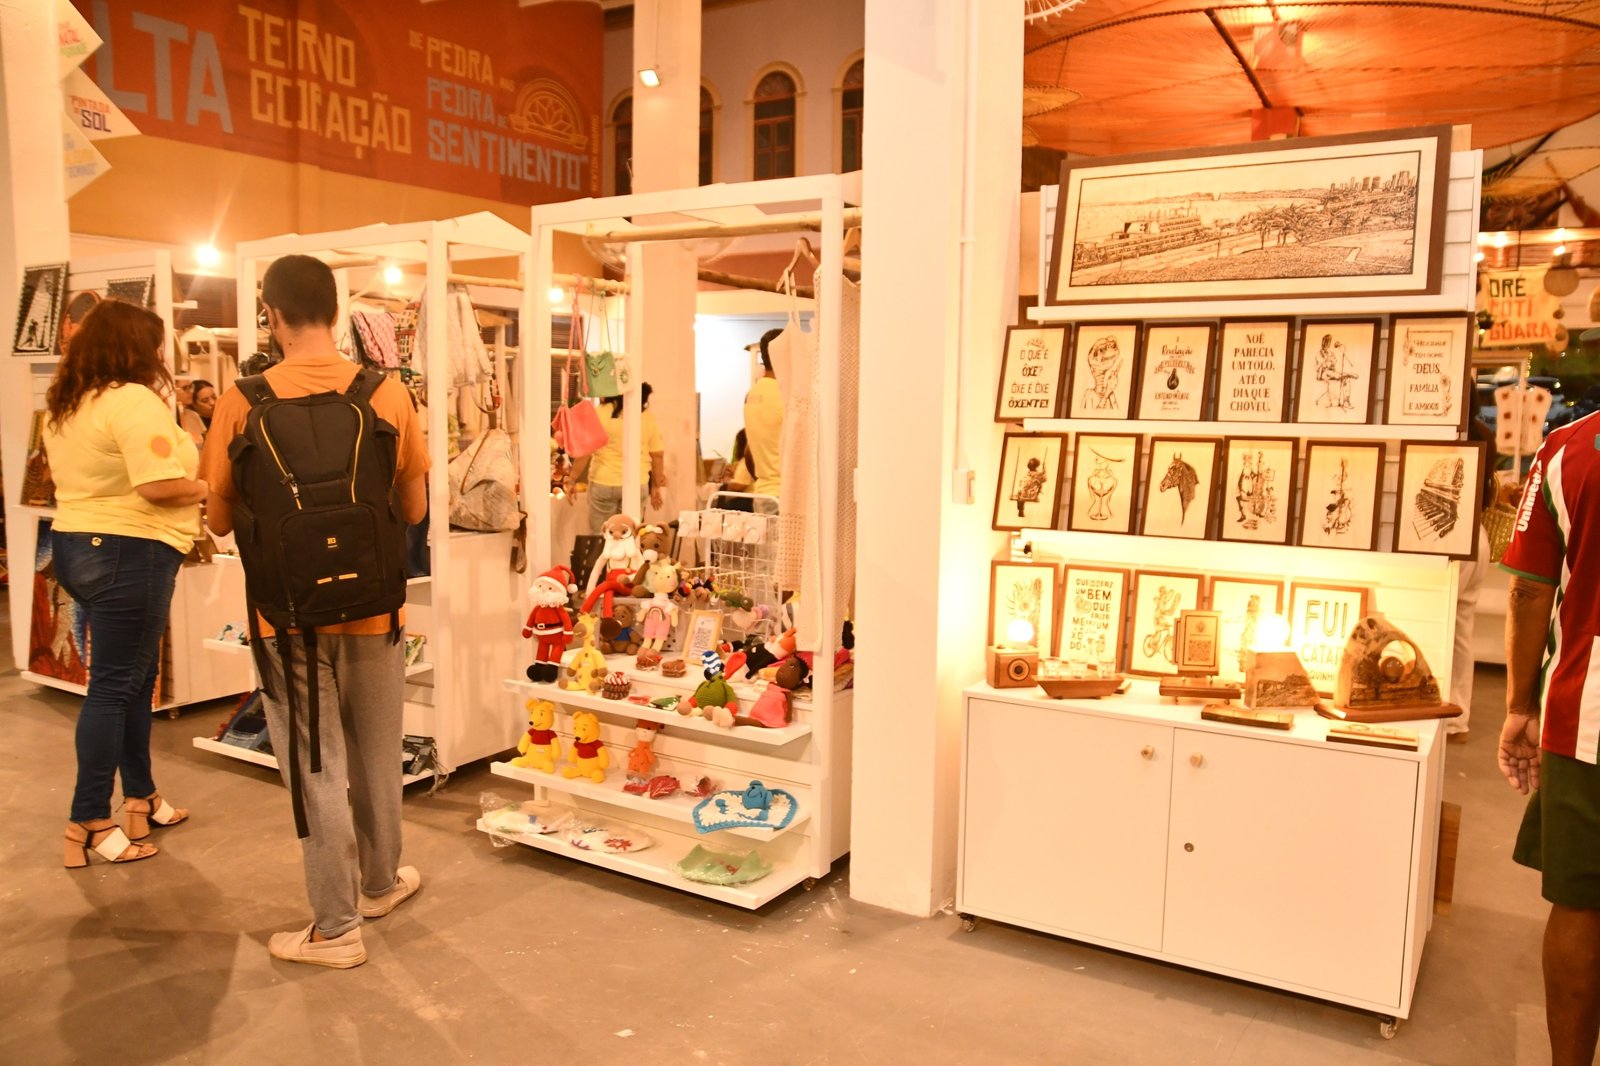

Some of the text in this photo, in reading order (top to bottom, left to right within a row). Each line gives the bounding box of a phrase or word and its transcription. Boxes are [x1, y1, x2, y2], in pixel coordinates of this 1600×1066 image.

[408, 29, 424, 50] DE
[90, 0, 234, 134] LTA
[426, 76, 497, 125] PEDRA
[80, 108, 112, 133] SOL
[250, 68, 412, 160] CORAÇÃO
[1246, 331, 1265, 345] NOÉ
[1019, 349, 1026, 360] O
[1027, 349, 1042, 361] QUE
[1233, 347, 1274, 358] PARECIA
[1231, 360, 1246, 371] UM
[1238, 373, 1266, 385] ATÉ O
[1232, 387, 1271, 400] DIA QUE
[1408, 402, 1414, 411] E
[1075, 587, 1112, 601] UM BEM
[1093, 602, 1112, 612] QUE
[1072, 616, 1086, 626] ME
[1096, 621, 1109, 630] UM
[1305, 599, 1349, 639] FUI
